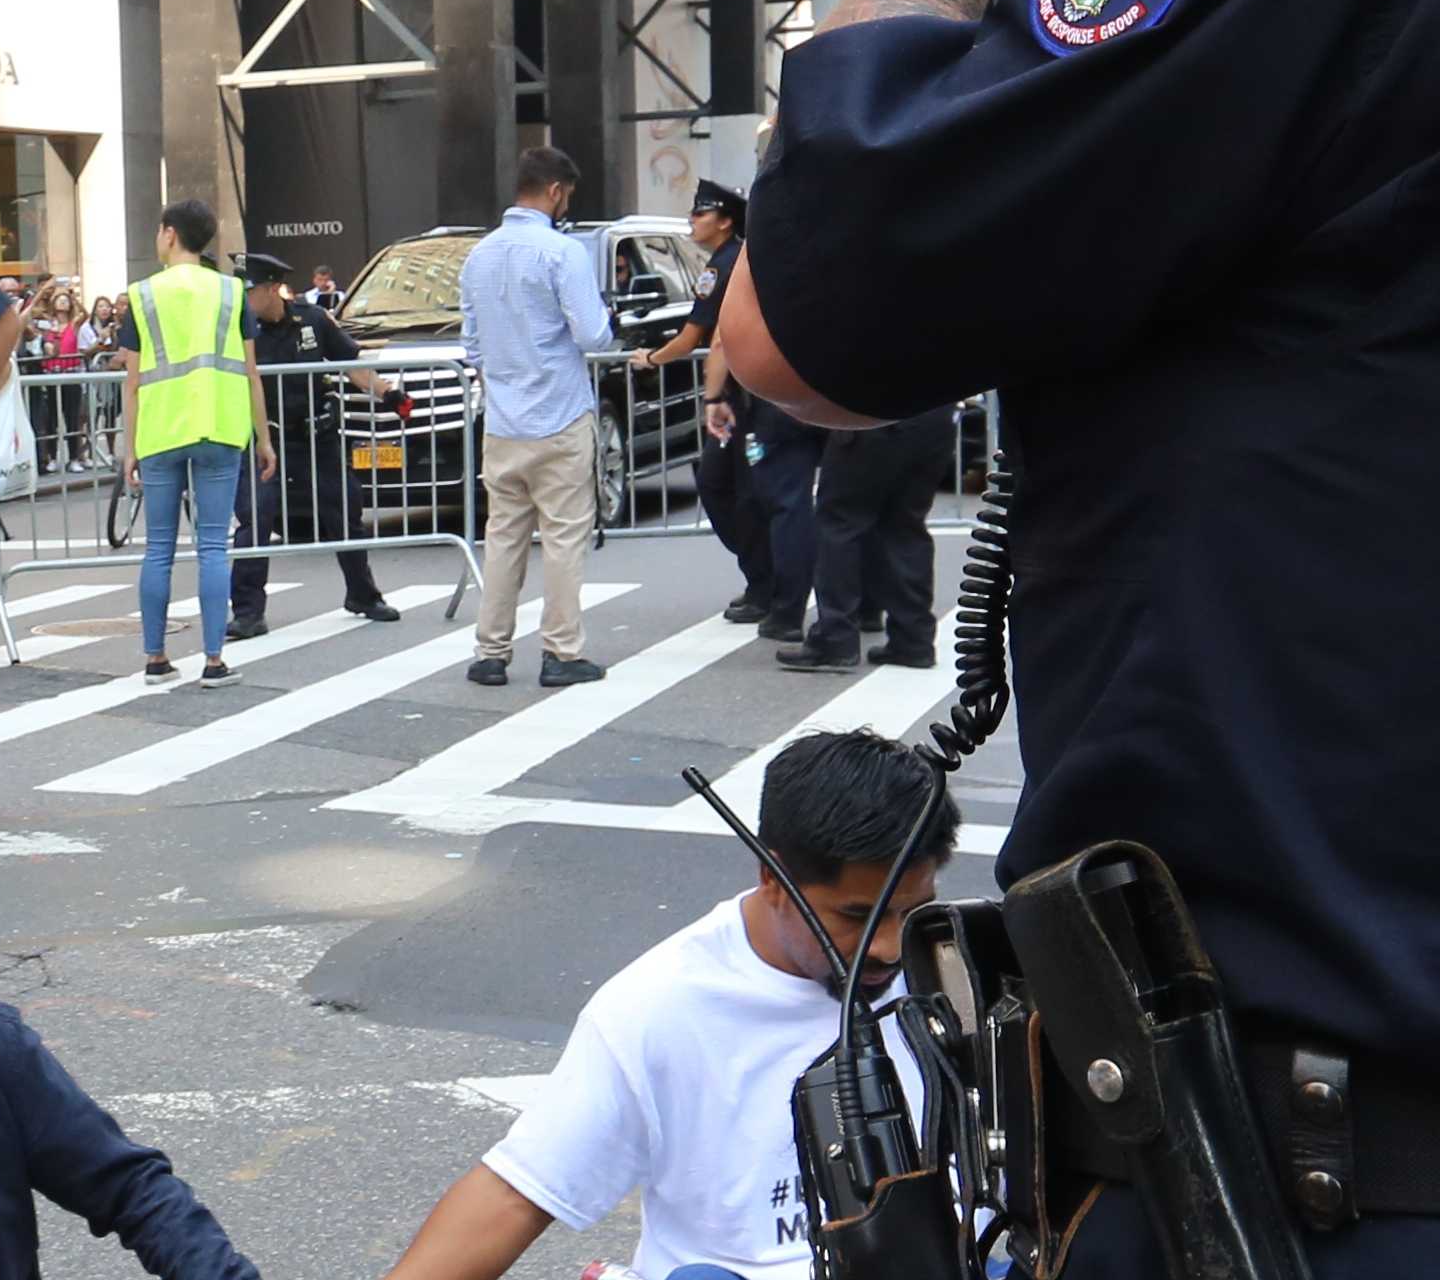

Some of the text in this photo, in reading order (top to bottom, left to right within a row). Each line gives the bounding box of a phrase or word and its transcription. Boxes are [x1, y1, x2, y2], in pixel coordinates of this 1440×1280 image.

[1046, 14, 1096, 45] RESPONSE
[1099, 5, 1141, 41] GROUP
[265, 220, 344, 238] MIKIMOTO
